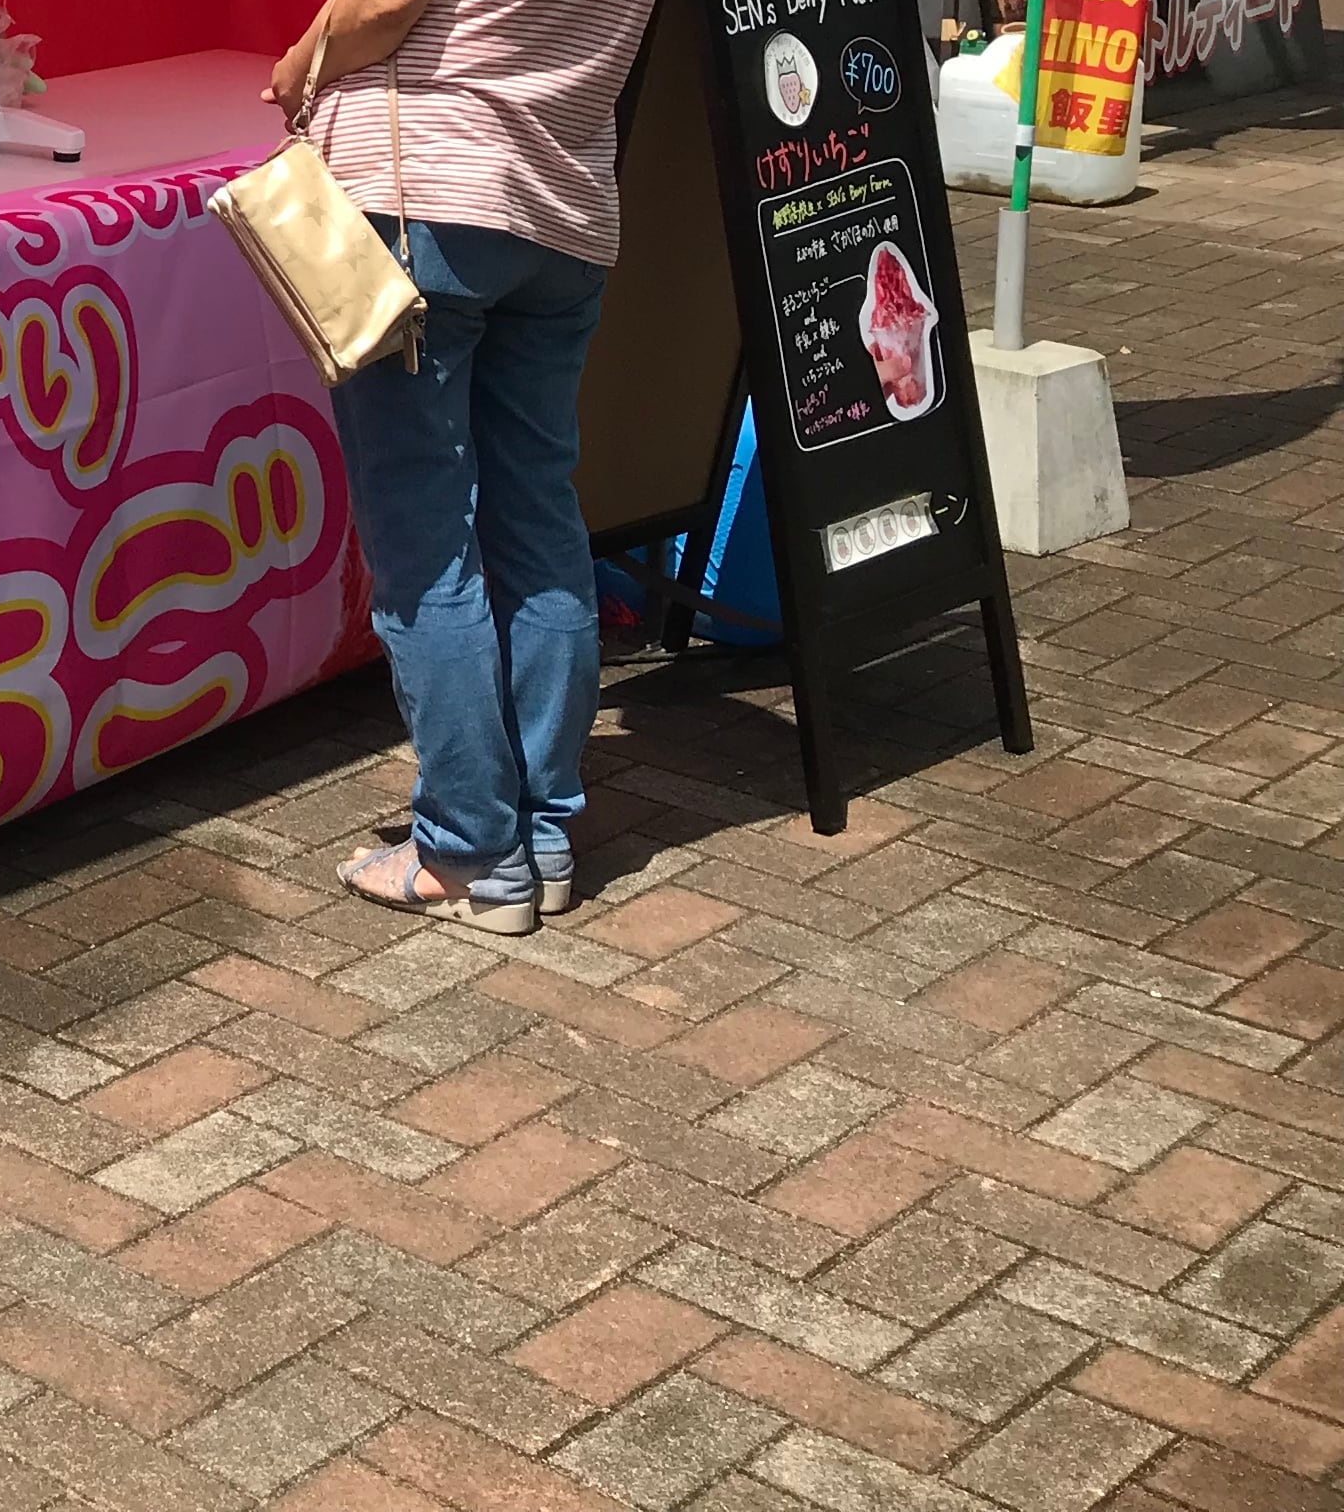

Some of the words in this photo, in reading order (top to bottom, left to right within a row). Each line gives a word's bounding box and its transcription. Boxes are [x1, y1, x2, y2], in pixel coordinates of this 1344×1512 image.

[845, 48, 895, 94] ¥700
[757, 123, 871, 190] けずりいちご
